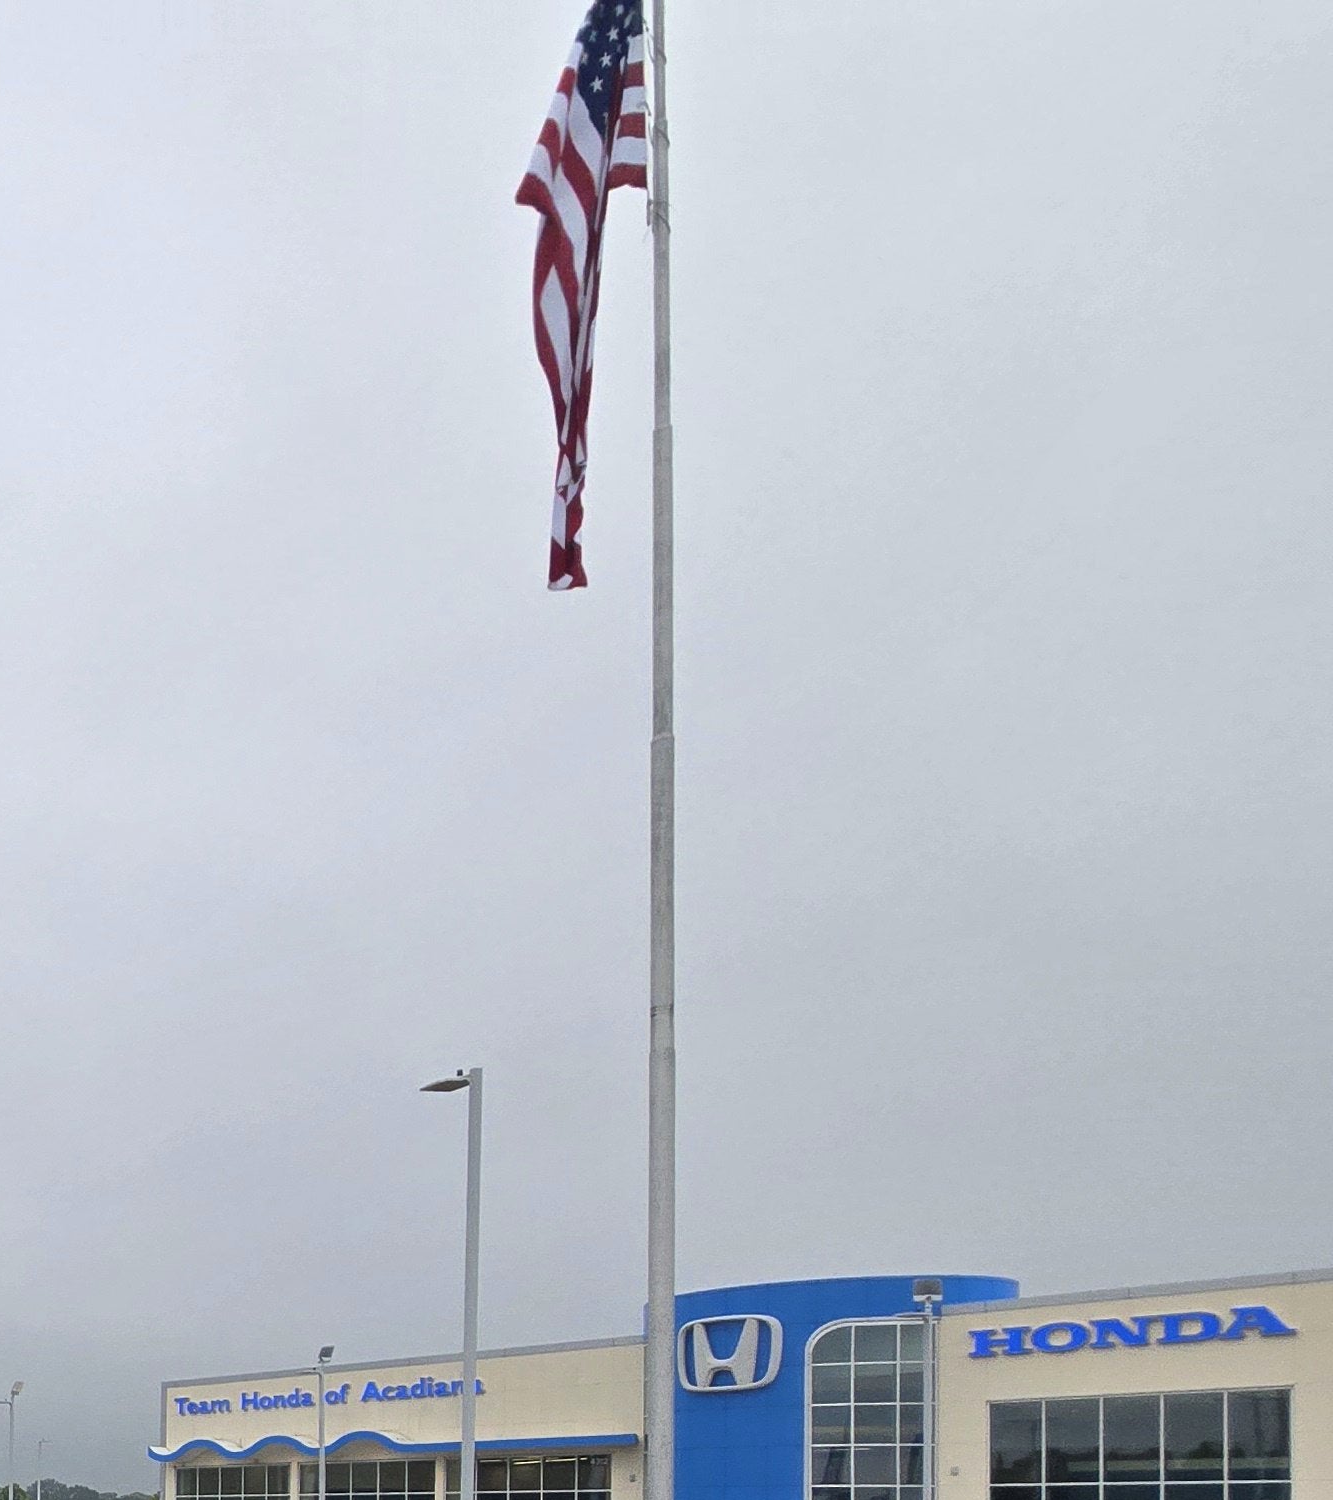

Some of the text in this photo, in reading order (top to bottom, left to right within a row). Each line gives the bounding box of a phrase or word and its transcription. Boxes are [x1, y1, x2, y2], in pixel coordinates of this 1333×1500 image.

[968, 1305, 1297, 1358] HONDA
[175, 1396, 230, 1417] Team
[241, 1388, 316, 1412] Honda
[325, 1383, 350, 1405] of
